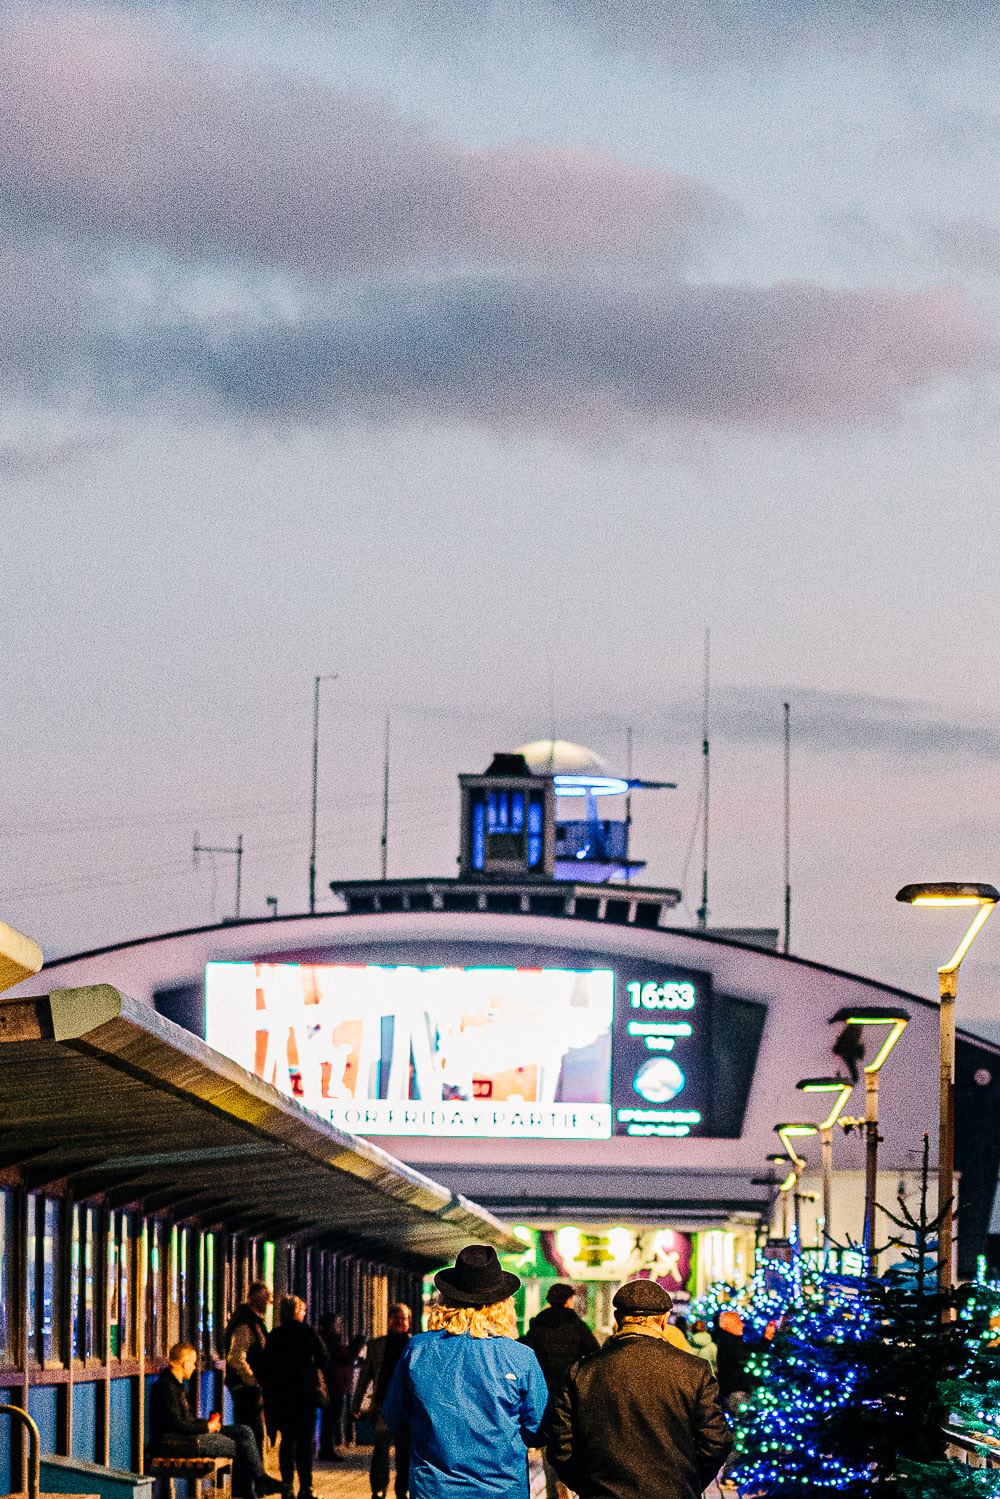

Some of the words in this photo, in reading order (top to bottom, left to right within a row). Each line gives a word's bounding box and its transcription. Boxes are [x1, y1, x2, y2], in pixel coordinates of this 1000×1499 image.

[626, 980, 696, 1011] 16:53
[330, 1109, 378, 1124] FOR
[389, 1110, 482, 1125] FRIDAY
[493, 1112, 602, 1128] PARTIES
